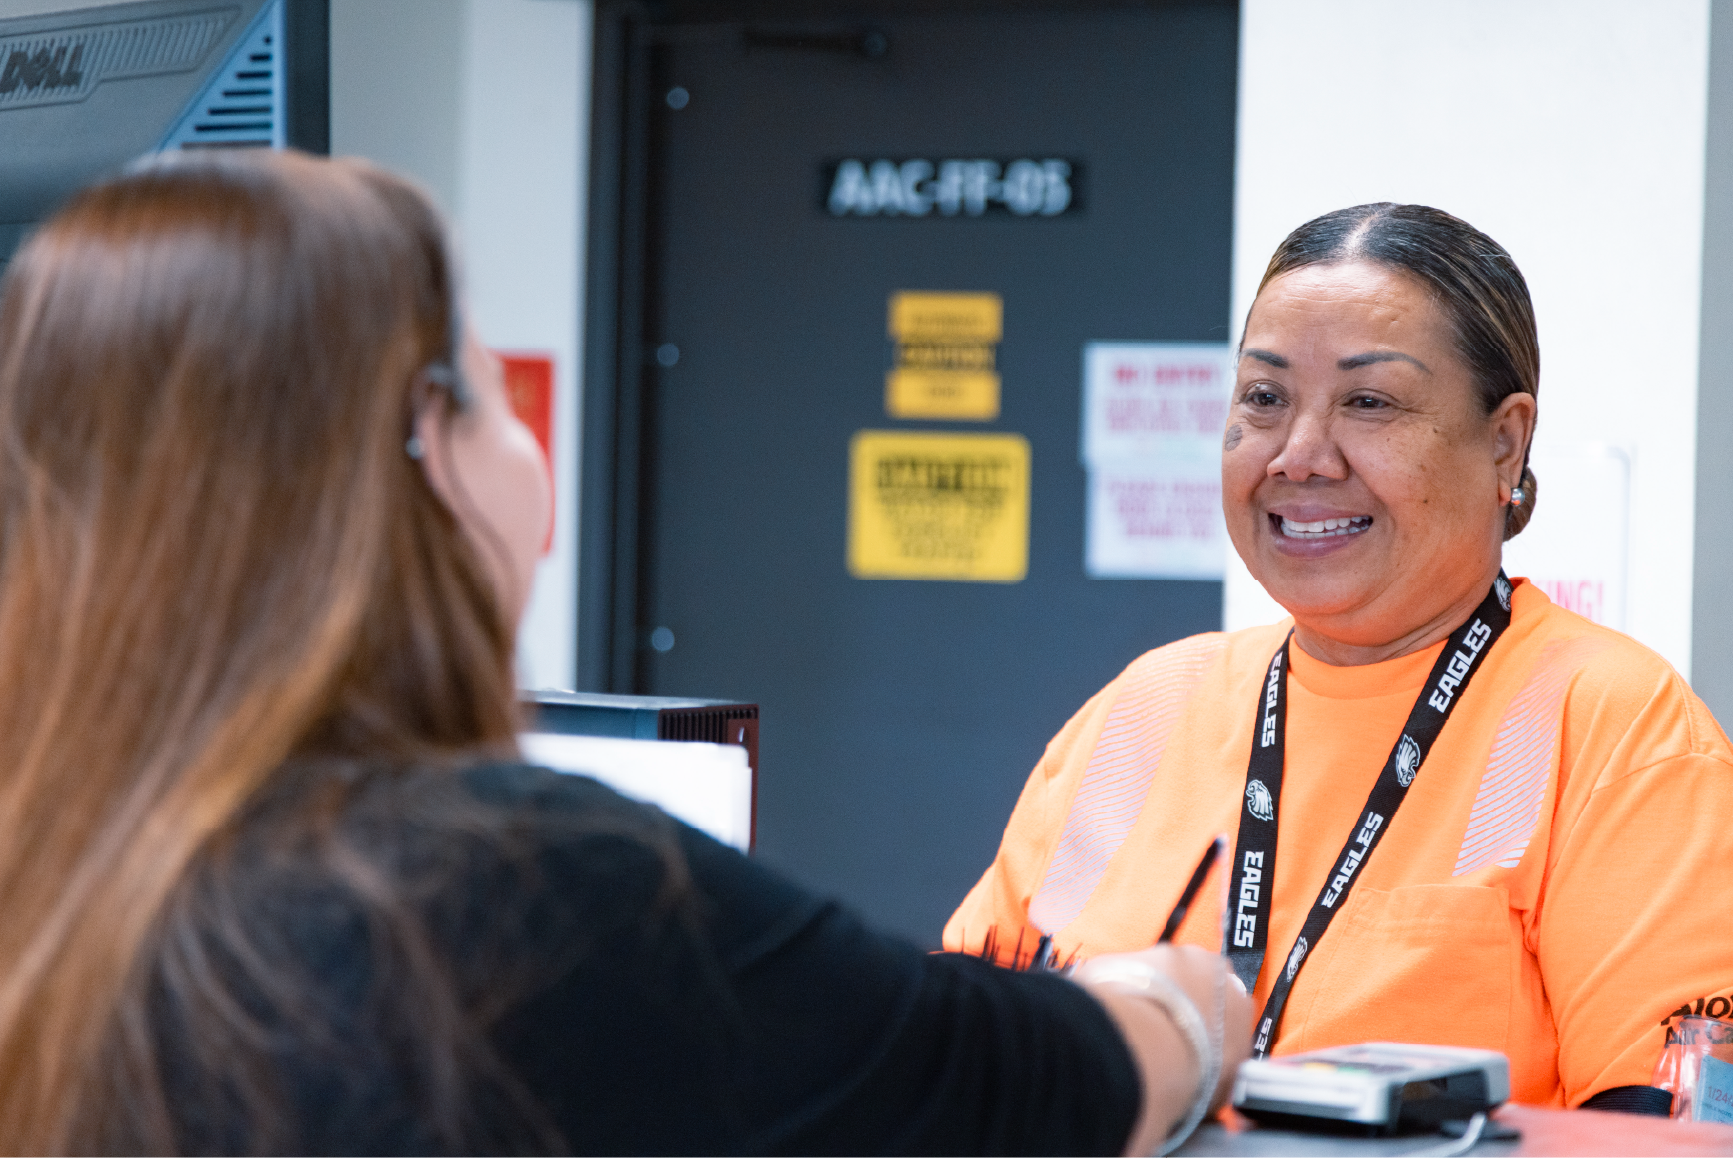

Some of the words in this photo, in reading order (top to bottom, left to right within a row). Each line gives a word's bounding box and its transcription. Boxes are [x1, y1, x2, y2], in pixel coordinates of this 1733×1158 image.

[829, 159, 1071, 215] AAC-FF-05
[1261, 651, 1283, 748] EAGLES
[1428, 618, 1492, 713] EAGLES
[1234, 850, 1264, 948] EAGLES
[1321, 811, 1384, 908] EAGLES
